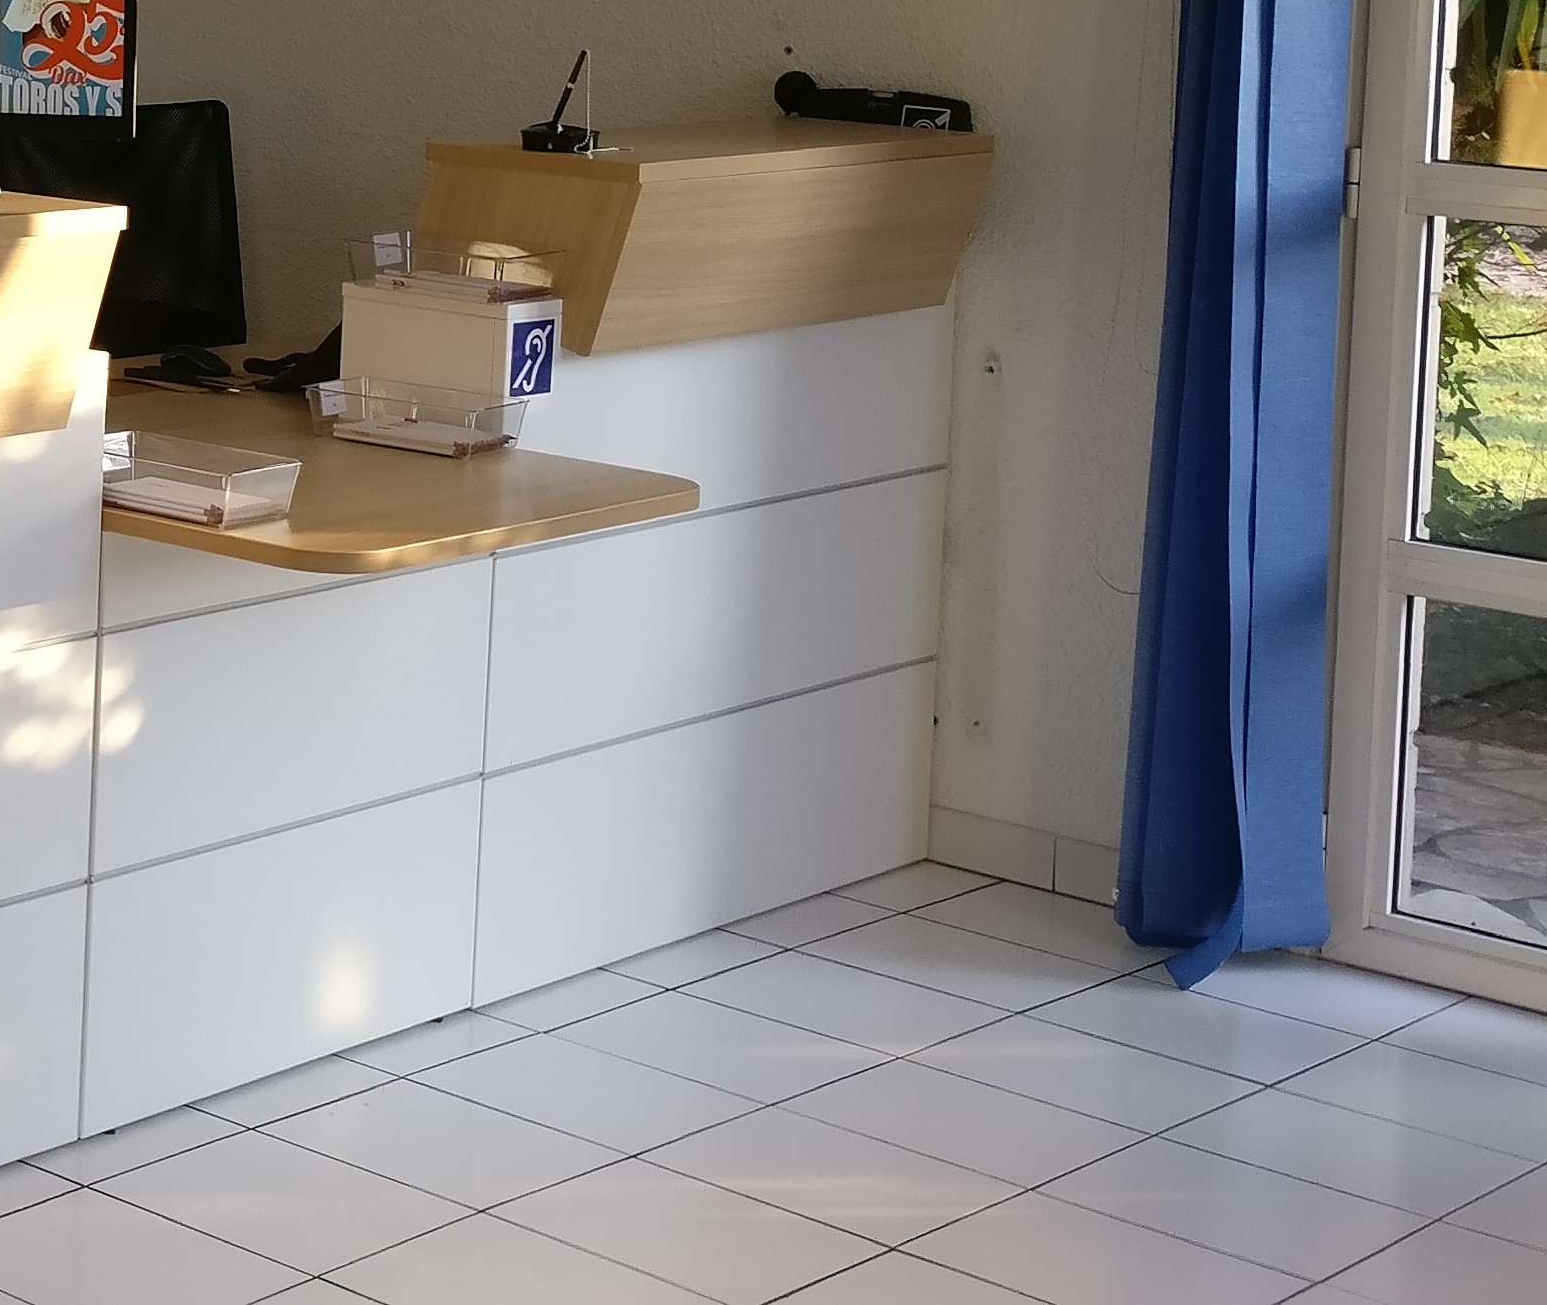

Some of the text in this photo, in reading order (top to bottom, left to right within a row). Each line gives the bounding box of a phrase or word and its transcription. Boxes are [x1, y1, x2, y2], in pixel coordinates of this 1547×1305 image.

[0, 64, 33, 81] FESTIVAL
[0, 74, 79, 115] TOROS
[85, 86, 101, 116] Y
